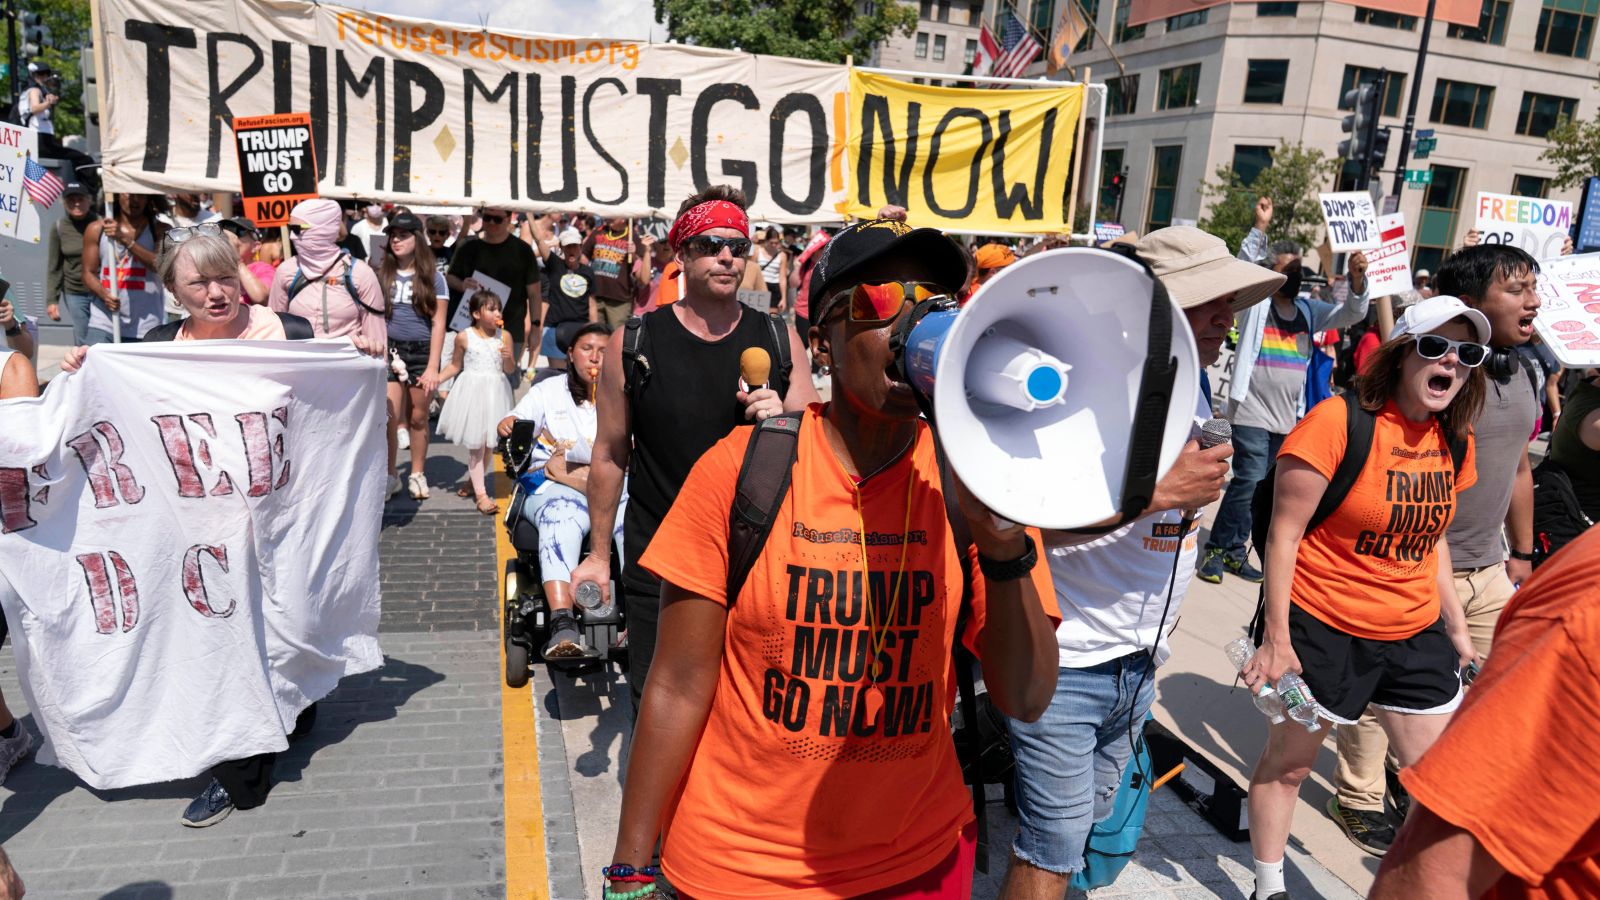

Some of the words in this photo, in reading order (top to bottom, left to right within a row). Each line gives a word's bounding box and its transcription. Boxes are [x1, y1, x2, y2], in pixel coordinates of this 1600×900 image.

[125, 18, 445, 193] TRUMP
[462, 68, 682, 209] MUST
[857, 93, 1058, 221] NOW
[0, 127, 21, 148] AT
[237, 127, 309, 151] TRUMP
[247, 149, 304, 173] MUST
[263, 171, 293, 193] GO
[1323, 200, 1356, 218] DUMP
[1479, 196, 1570, 229] FREEDOM
[1329, 219, 1368, 244] TRUMP
[0, 406, 291, 534] FREE
[1385, 469, 1453, 503] TRUMP
[1164, 525, 1180, 535] FAS
[1384, 503, 1452, 534] MUST
[1142, 536, 1178, 552] TRUM
[1354, 529, 1394, 559] GO
[786, 563, 935, 627] TRUMP
[791, 624, 919, 683] MUST
[762, 667, 811, 732] GO
[819, 679, 934, 738] NOW!
